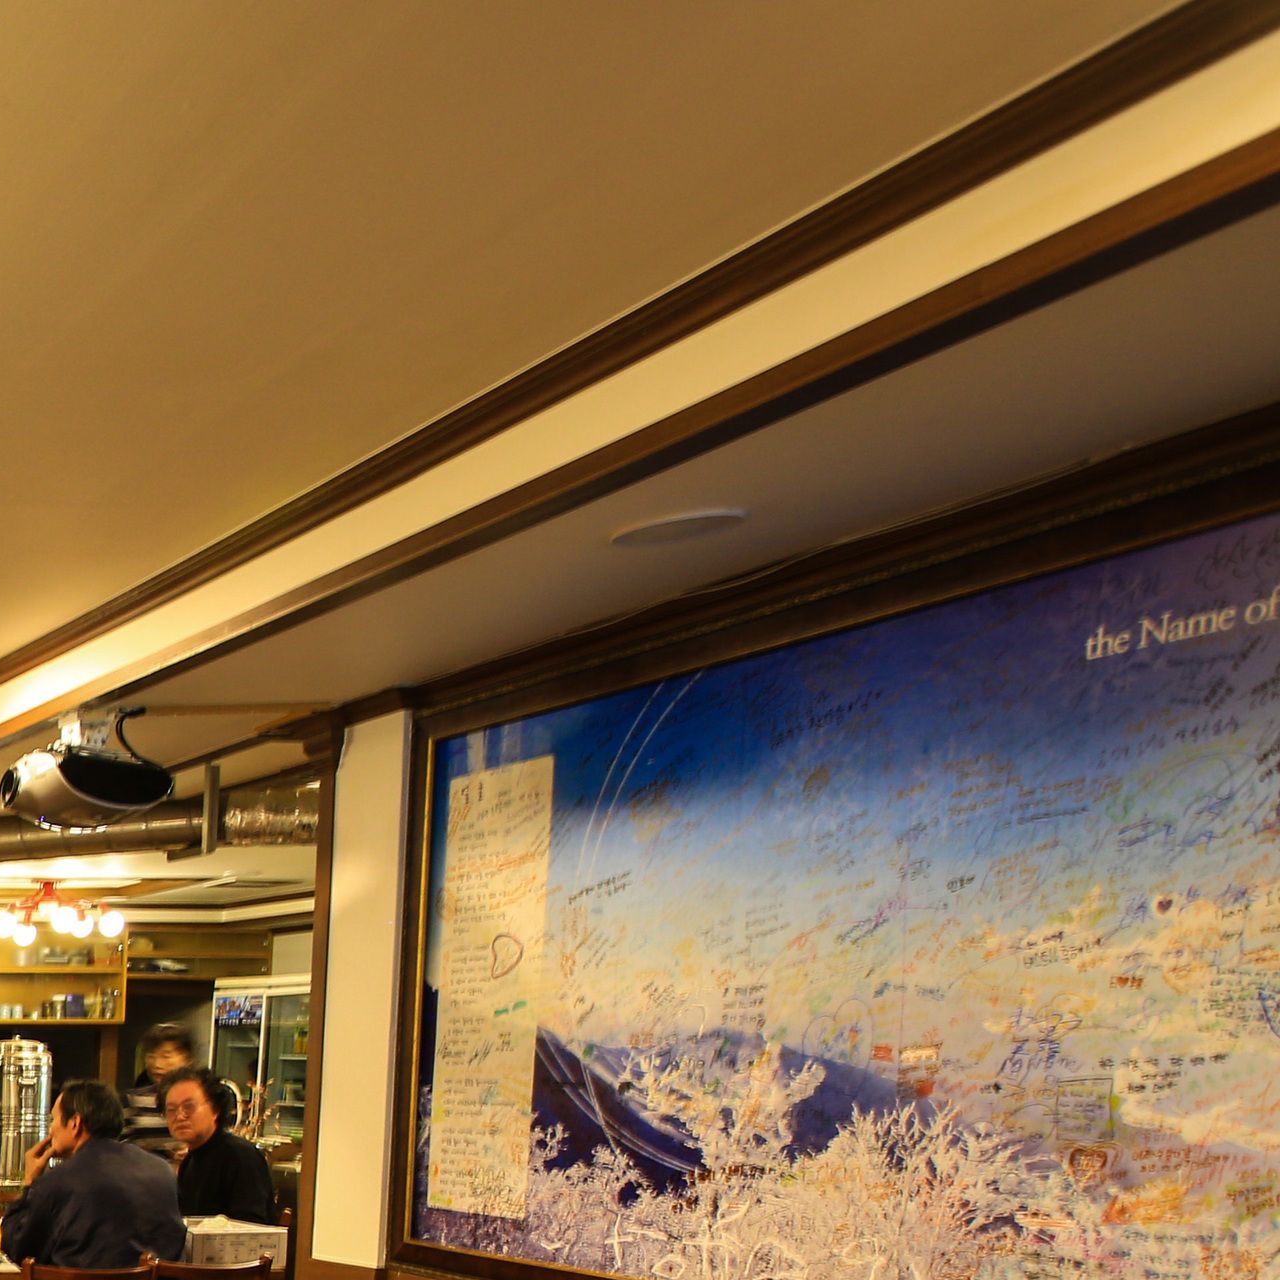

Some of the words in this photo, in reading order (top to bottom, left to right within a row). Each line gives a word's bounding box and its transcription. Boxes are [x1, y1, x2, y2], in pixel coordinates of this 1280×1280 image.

[1084, 624, 1132, 661] the
[1137, 605, 1237, 649] Name
[1244, 585, 1280, 625] of
